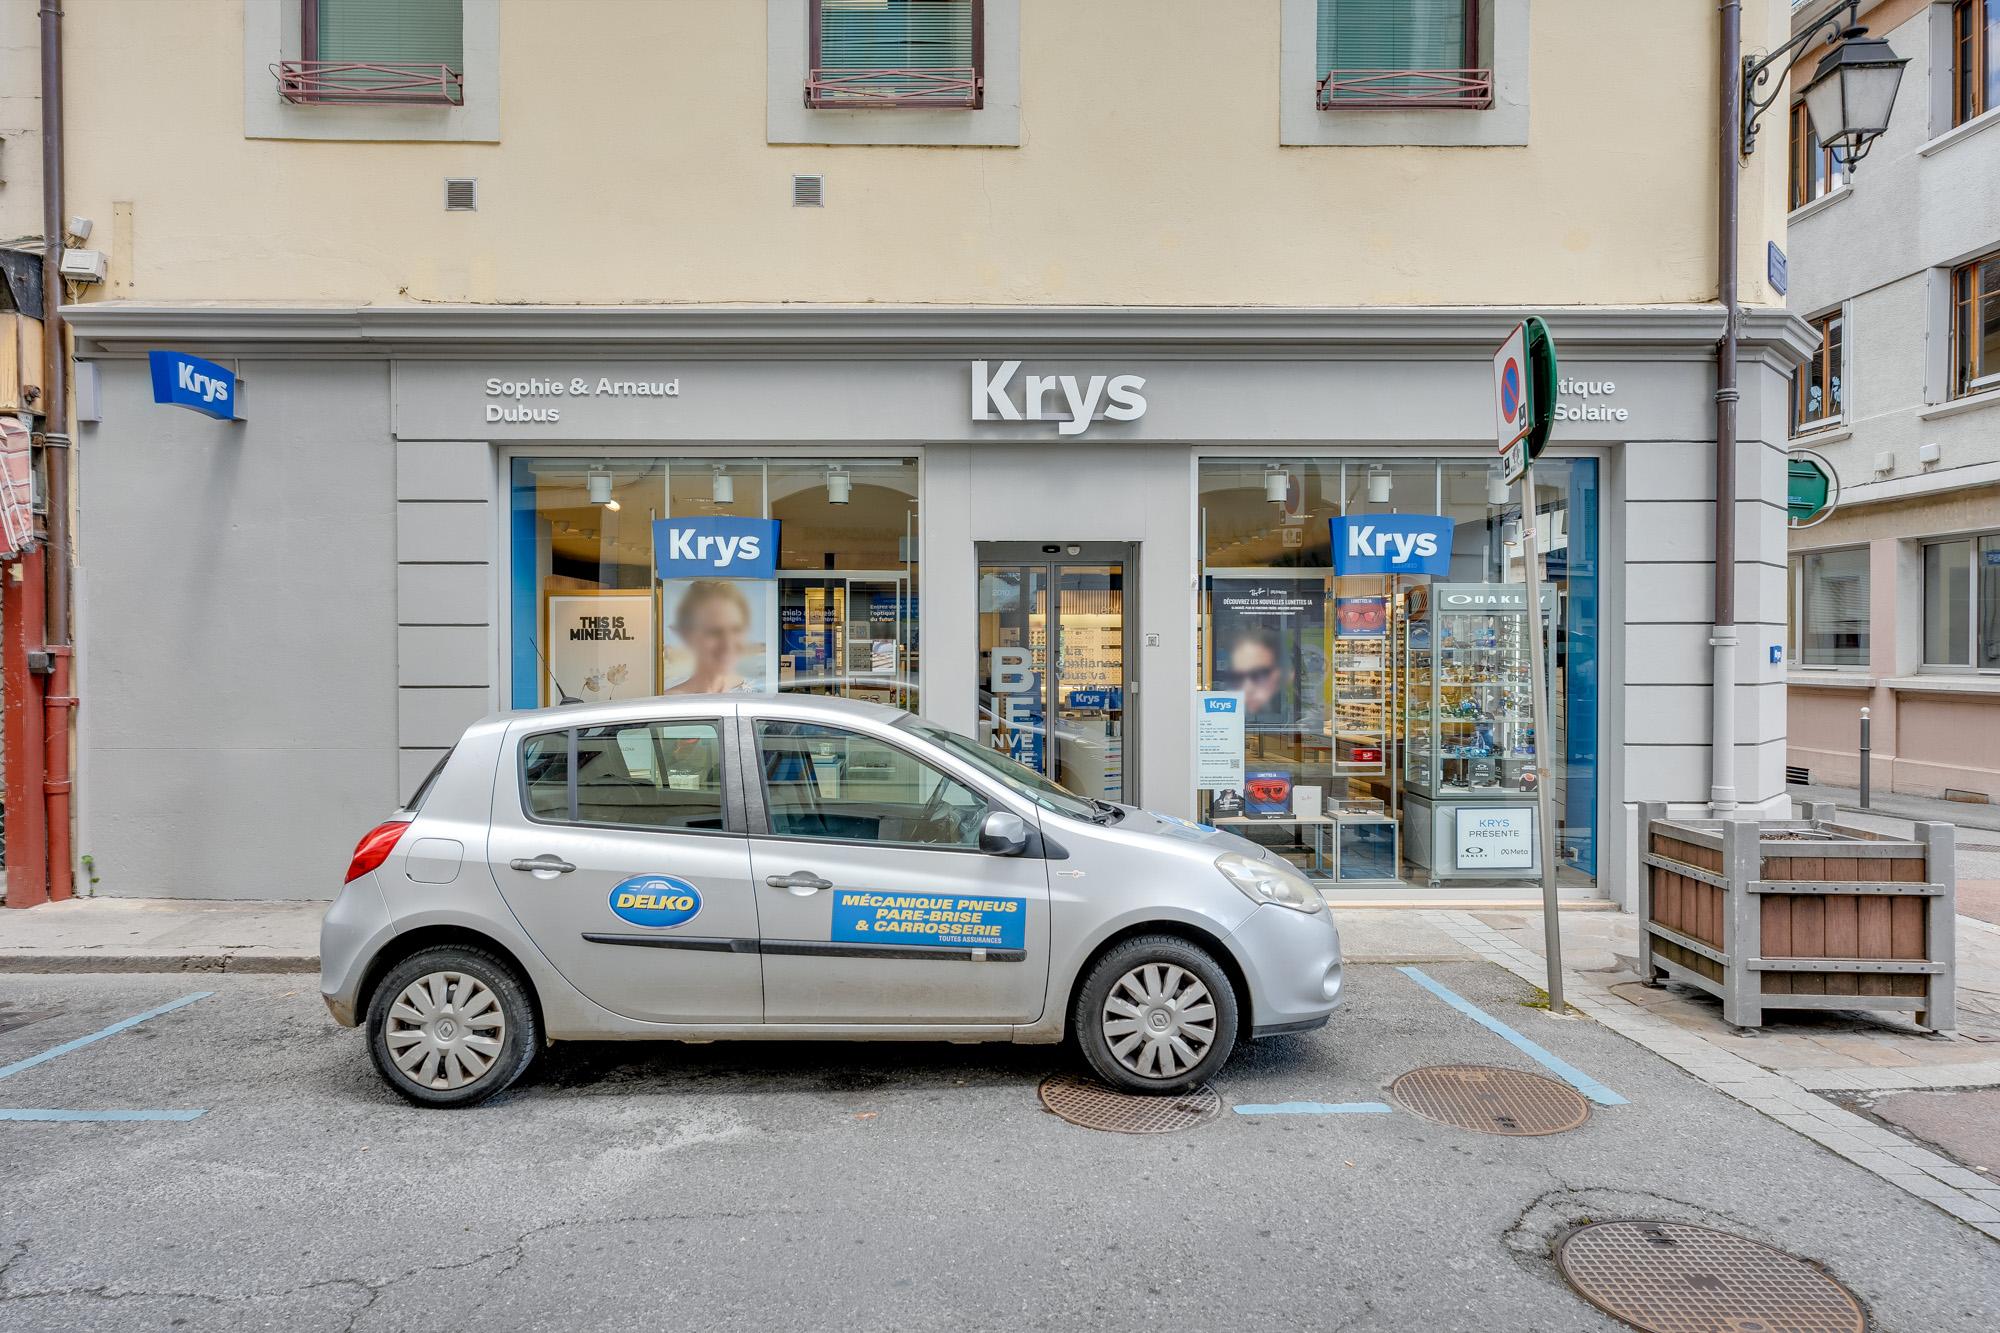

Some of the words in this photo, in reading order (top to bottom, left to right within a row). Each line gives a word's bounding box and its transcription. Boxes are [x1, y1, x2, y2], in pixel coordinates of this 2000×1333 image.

[178, 361, 228, 403] Krys
[485, 377, 564, 399] Sophie
[569, 378, 590, 396] &
[595, 377, 680, 397] Arnaud
[1557, 377, 1616, 399] tique
[971, 359, 1147, 436] Krys
[485, 404, 560, 423] Dubus
[1553, 404, 1629, 421] Solaire
[669, 528, 761, 568] Krys
[1348, 525, 1438, 564] Krys
[1474, 595, 1546, 604] OAKLY
[579, 616, 610, 629] THIS
[612, 616, 625, 629] IS
[569, 628, 635, 641] MINERAL.
[991, 647, 1035, 693] B
[1075, 693, 1100, 704] Krys
[1209, 700, 1232, 711] Krys
[991, 733, 1034, 748] NVE
[1479, 819, 1510, 828] KRYS
[1469, 829, 1520, 838] PRÉSENTE
[616, 893, 694, 912] DELKO
[841, 893, 954, 911] MÉCANIQUE
[957, 898, 1018, 913] PNEUS
[876, 909, 983, 923] PARE-BRISE
[855, 919, 869, 931] &
[873, 919, 1002, 937] CARROSSERIE
[938, 935, 960, 943] TOUTES
[960, 936, 1003, 944] ASSURANCES
